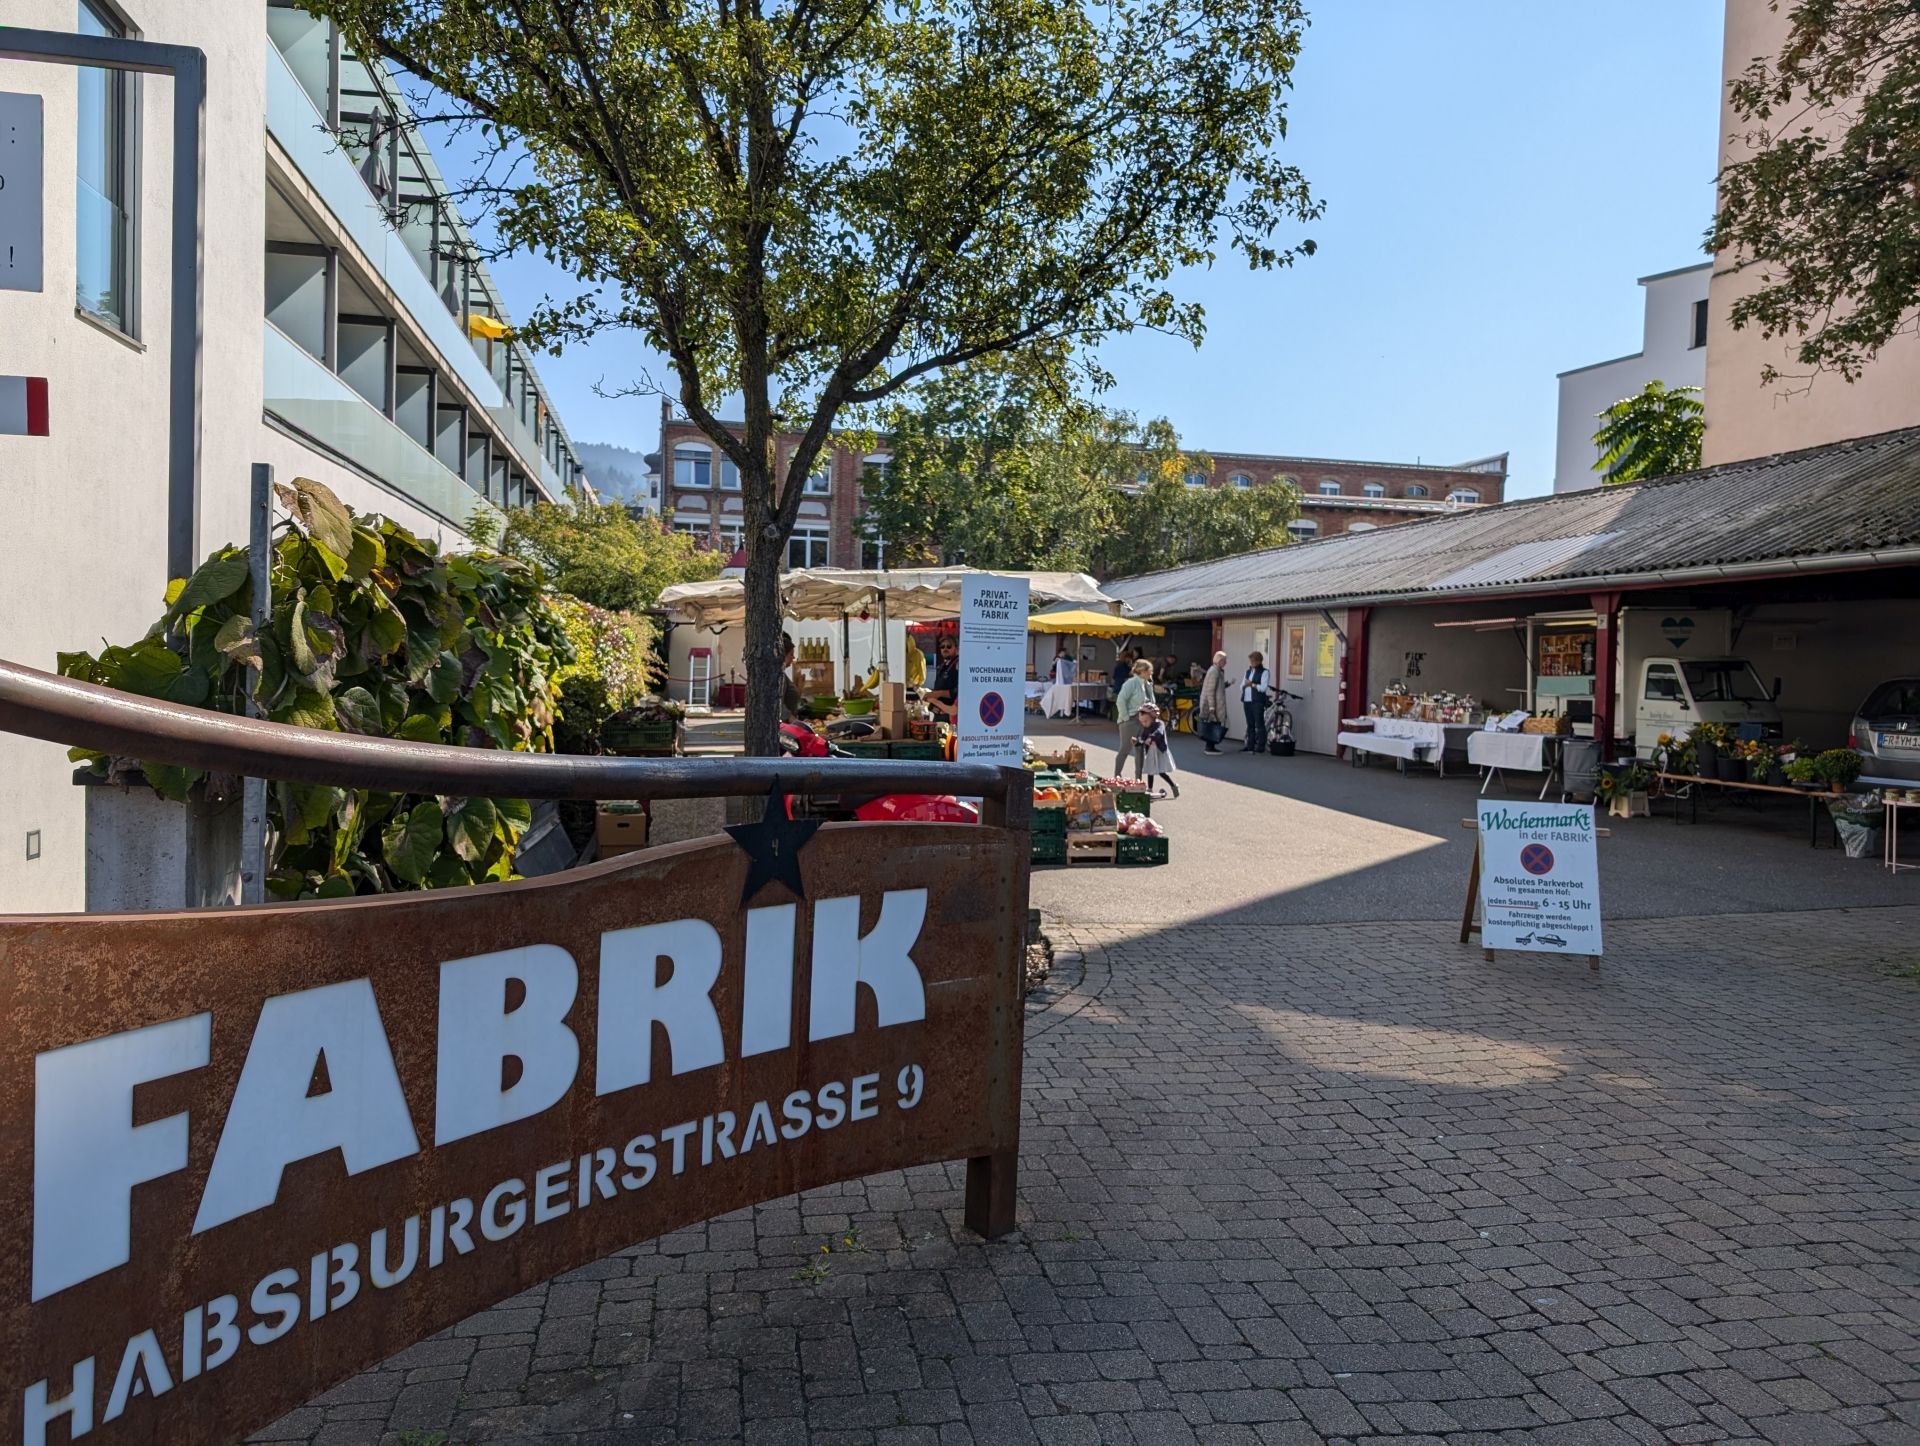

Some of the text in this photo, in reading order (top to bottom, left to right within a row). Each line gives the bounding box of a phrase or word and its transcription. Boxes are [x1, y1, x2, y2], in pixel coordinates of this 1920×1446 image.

[981, 589, 1011, 599] PRIVAT-
[973, 598, 1018, 609] PARKPLATZ
[981, 610, 1009, 619] FABRIK
[969, 666, 1016, 674] WOCHENMARKT
[976, 750, 995, 758] Samstag
[1481, 808, 1591, 831] Wochenmarkt
[1519, 830, 1589, 843] in der FABRIK
[1493, 876, 1584, 889] Absolutes Parkverbot
[1518, 887, 1554, 895] gesamten
[1555, 888, 1571, 896] Hof:
[1488, 897, 1506, 906] jeden
[1542, 898, 1549, 908] 6
[1559, 901, 1570, 911] 15
[1572, 900, 1592, 910] Uhr
[1508, 911, 1545, 921] Fahrzeuge
[1488, 918, 1540, 929] kostenpflichtig
[1541, 921, 1589, 932] abgeschleppt
[31, 887, 929, 1304] FABRIK
[22, 1063, 925, 1446] HABSBURGERSTRASSE 9
